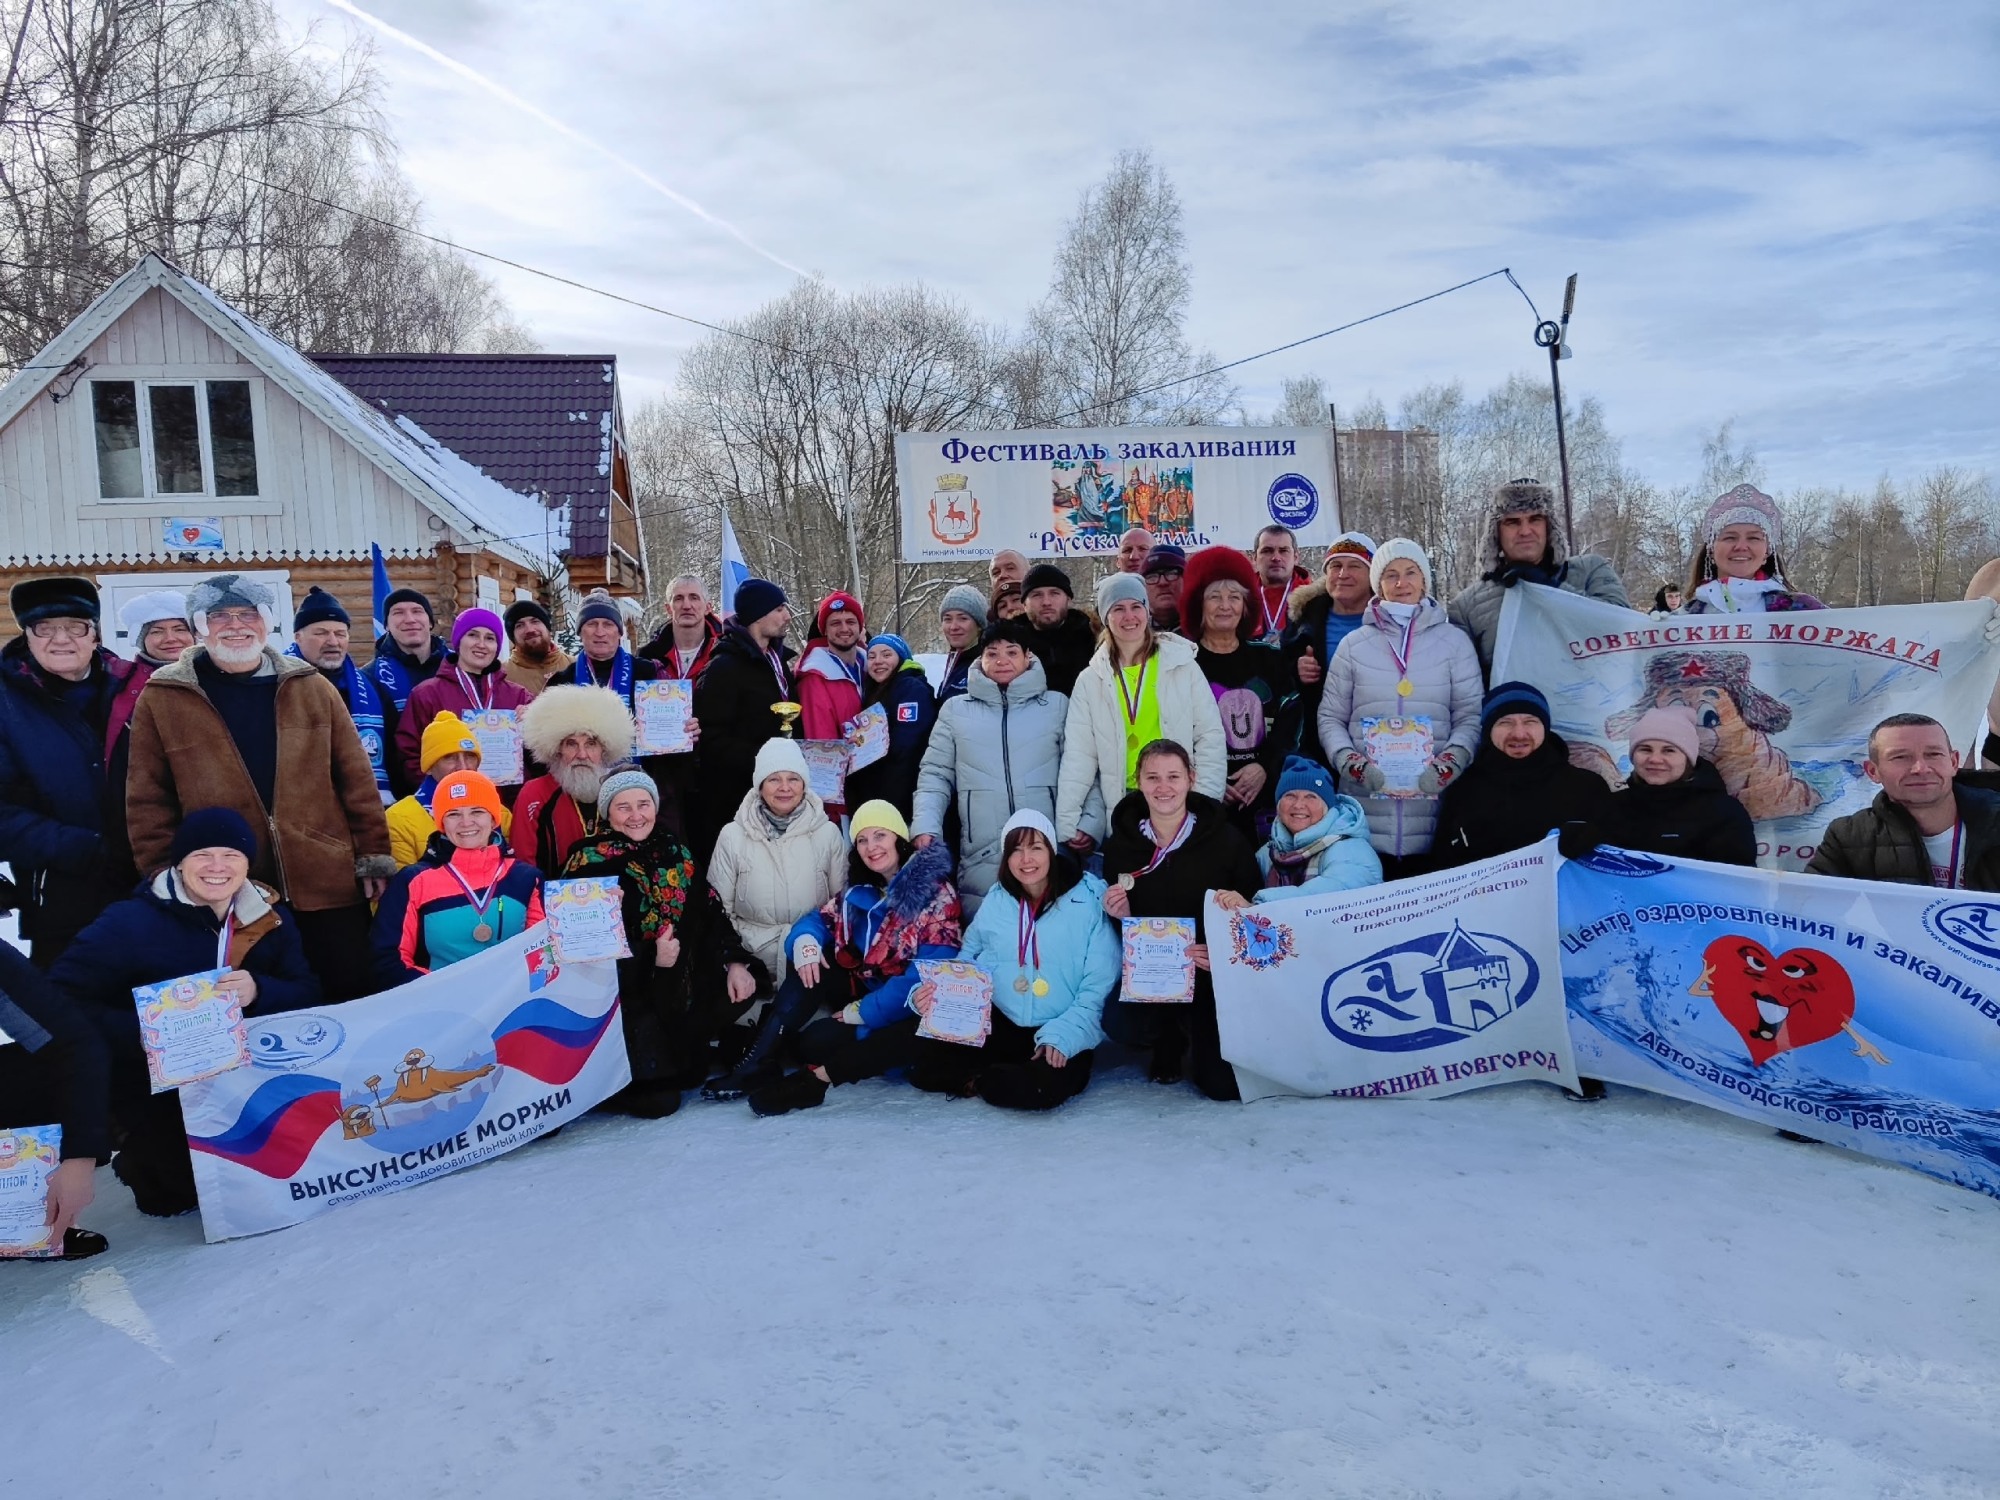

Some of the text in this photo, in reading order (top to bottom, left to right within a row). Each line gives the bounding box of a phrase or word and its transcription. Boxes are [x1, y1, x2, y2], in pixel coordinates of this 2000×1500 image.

[941, 438, 1297, 464] Фестиваль закаливания
[922, 548, 995, 557] Нижний Новгород
[1029, 531, 1119, 557] “Русска
[1568, 623, 1943, 667] СОВЕТСКИЕ МОРЖАТА
[452, 785, 464, 793] NO
[1304, 895, 1386, 917] Региональная
[1388, 873, 1469, 899] общественная
[1353, 877, 1529, 934] Нижегородской области»
[1920, 903, 1948, 947] ЗАКАЛИВАНИЯ
[1559, 903, 2000, 1027] Центр оздоровления и закалив
[1947, 945, 1994, 969] ФЕДЕРАЦИЯ
[173, 1011, 212, 1035] ДИПЛОМ
[1442, 1049, 1560, 1082] НОВГОРОД
[1636, 1030, 1955, 1138] Автозаводского района
[289, 1087, 573, 1202] ВЫКСУНСКИЕ МОРЖИ
[519, 1122, 545, 1140] КЛУБ
